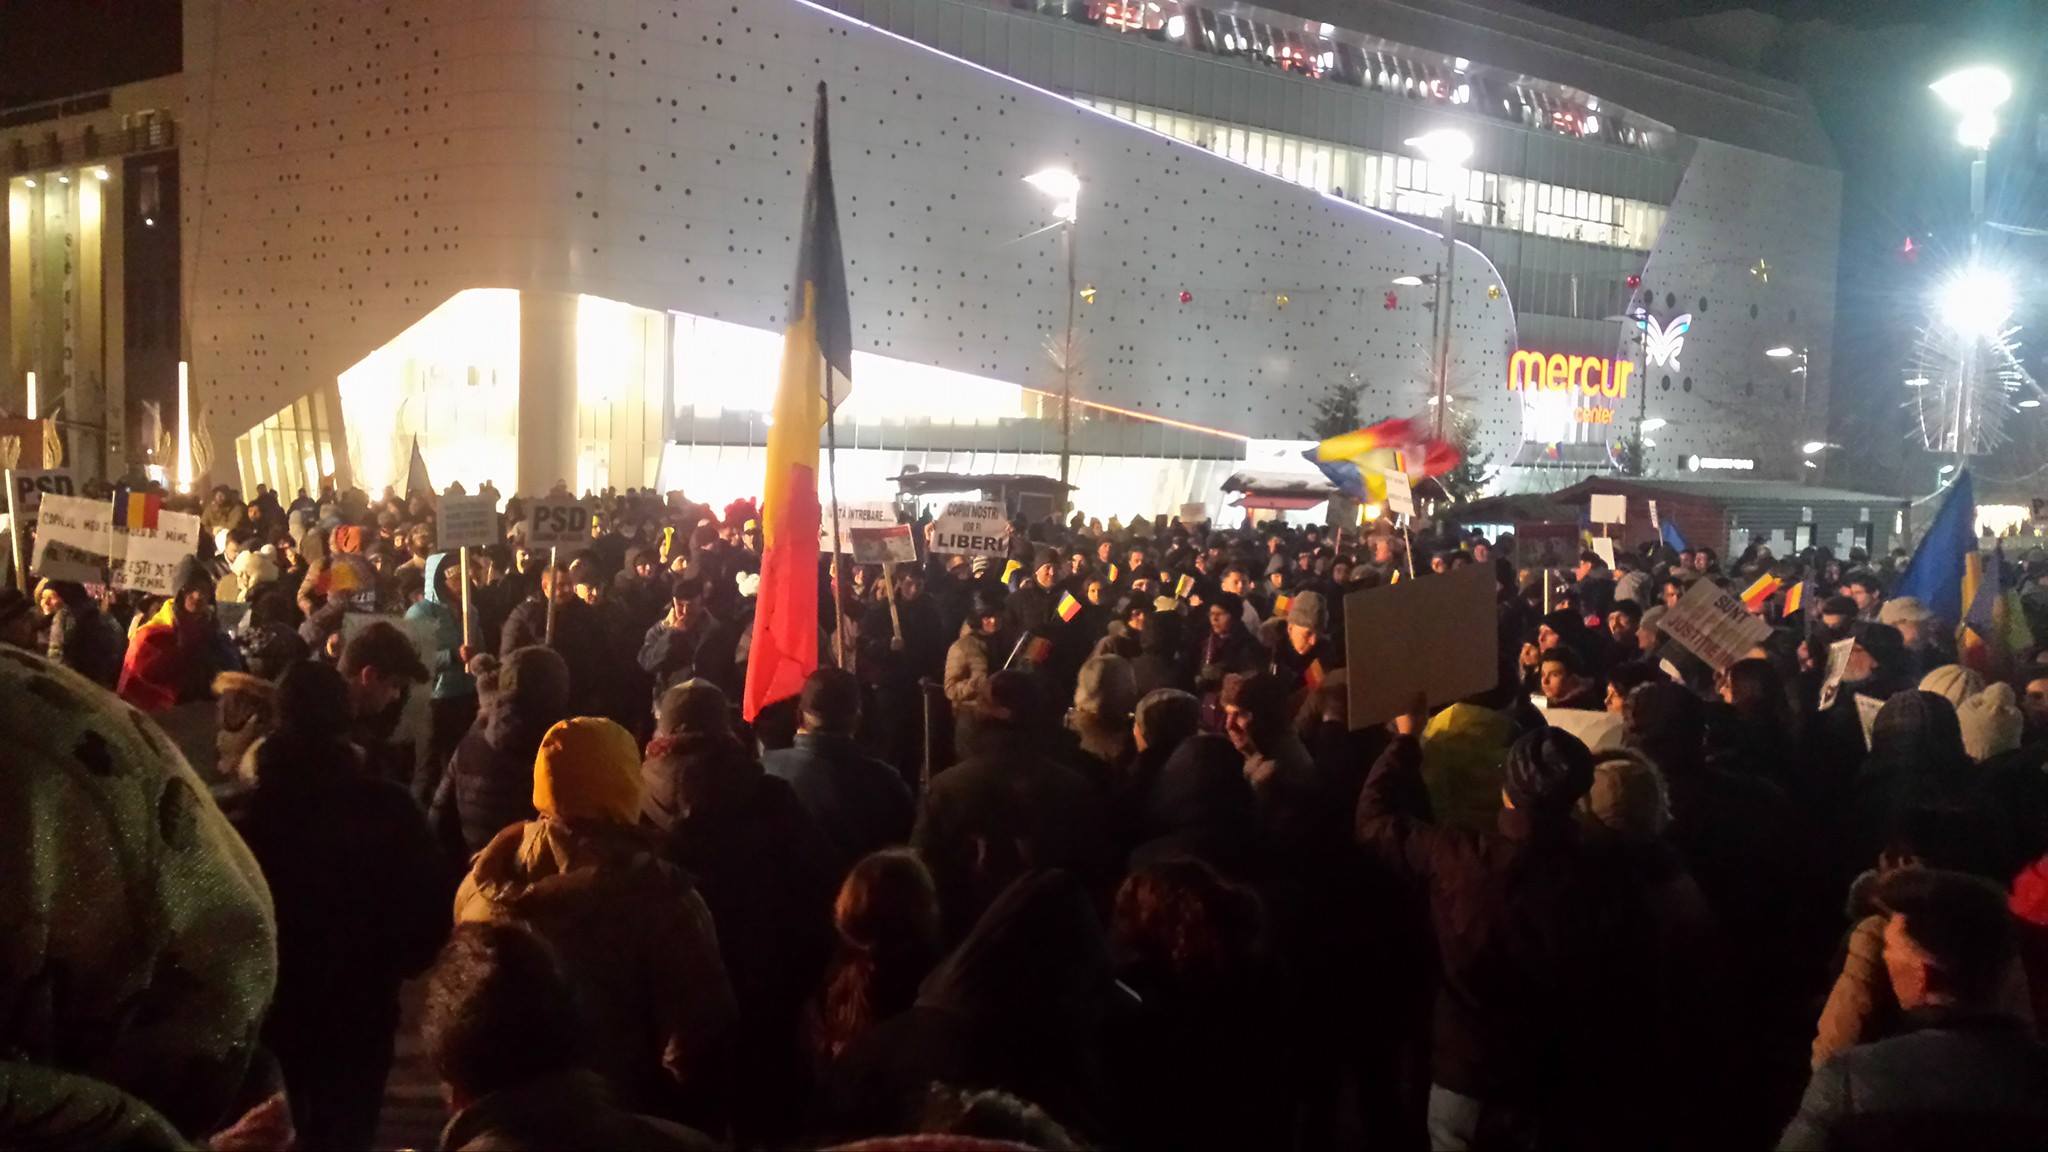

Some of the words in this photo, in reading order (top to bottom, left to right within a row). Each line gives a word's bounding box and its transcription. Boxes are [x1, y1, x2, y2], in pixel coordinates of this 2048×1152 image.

[1508, 350, 1634, 398] mercur
[1574, 405, 1615, 424] center
[17, 475, 73, 503] PSD
[533, 506, 587, 532] PSD
[938, 533, 1003, 551] LIBERI
[1713, 594, 1751, 625] SUNT
